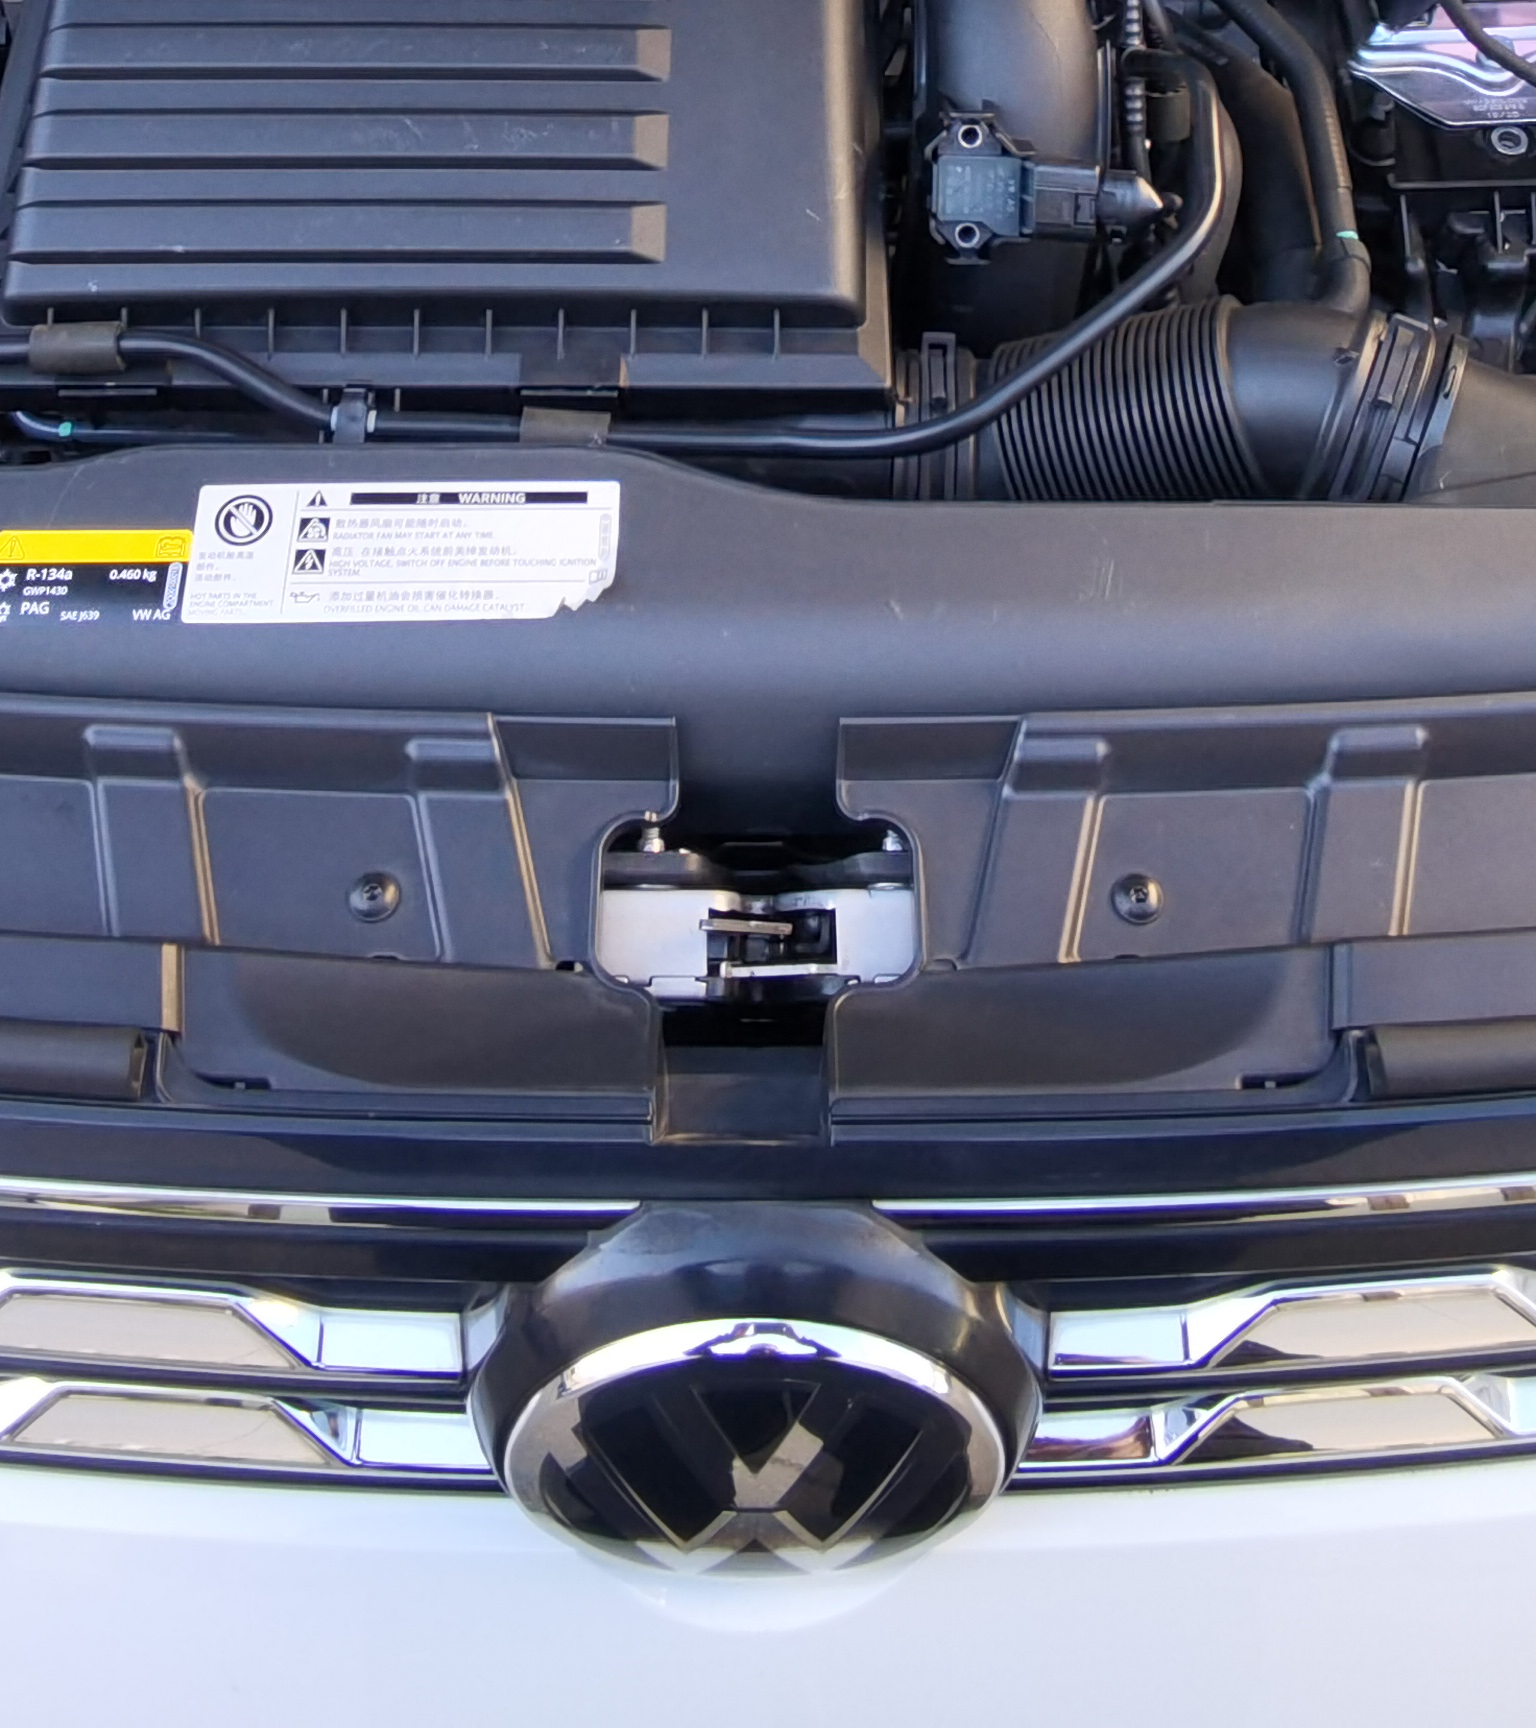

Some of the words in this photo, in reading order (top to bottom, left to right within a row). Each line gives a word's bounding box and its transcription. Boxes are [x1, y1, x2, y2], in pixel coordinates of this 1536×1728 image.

[416, 493, 441, 505] 注意
[458, 492, 526, 505] WARNING
[333, 532, 375, 540] RADIATOR
[376, 532, 393, 540] FAN
[394, 532, 413, 540] MAY
[415, 531, 440, 540] START
[442, 531, 454, 539] AT
[455, 531, 473, 539] ANY
[329, 559, 350, 568] HIGH
[396, 559, 428, 568] SWITCH
[429, 559, 446, 568] OFF
[448, 558, 477, 567] ENGINE
[480, 558, 511, 567] BEFORE
[513, 558, 557, 567] TOUCHING
[559, 557, 596, 566] IGNITION
[25, 568, 73, 581] R-134a
[109, 568, 141, 581] 0.460
[143, 569, 158, 582] kg
[22, 586, 68, 596] GWP1430
[190, 592, 207, 600] HOT
[208, 592, 231, 600] PARTS
[233, 592, 242, 600] IN
[243, 592, 257, 600] THE
[189, 600, 216, 608] ENGINE
[217, 599, 274, 608] COMPARTMENT
[323, 604, 373, 614] OVERFILLED
[374, 604, 405, 614] ENGINE
[407, 604, 421, 613] OIL
[423, 603, 442, 613] CAN
[444, 603, 480, 613] DAMAGE
[20, 601, 50, 615] PAG
[59, 610, 78, 621] SAE
[78, 610, 100, 622] J639
[132, 609, 153, 621] VW
[154, 609, 171, 621] AG
[188, 608, 218, 616] MOVING
